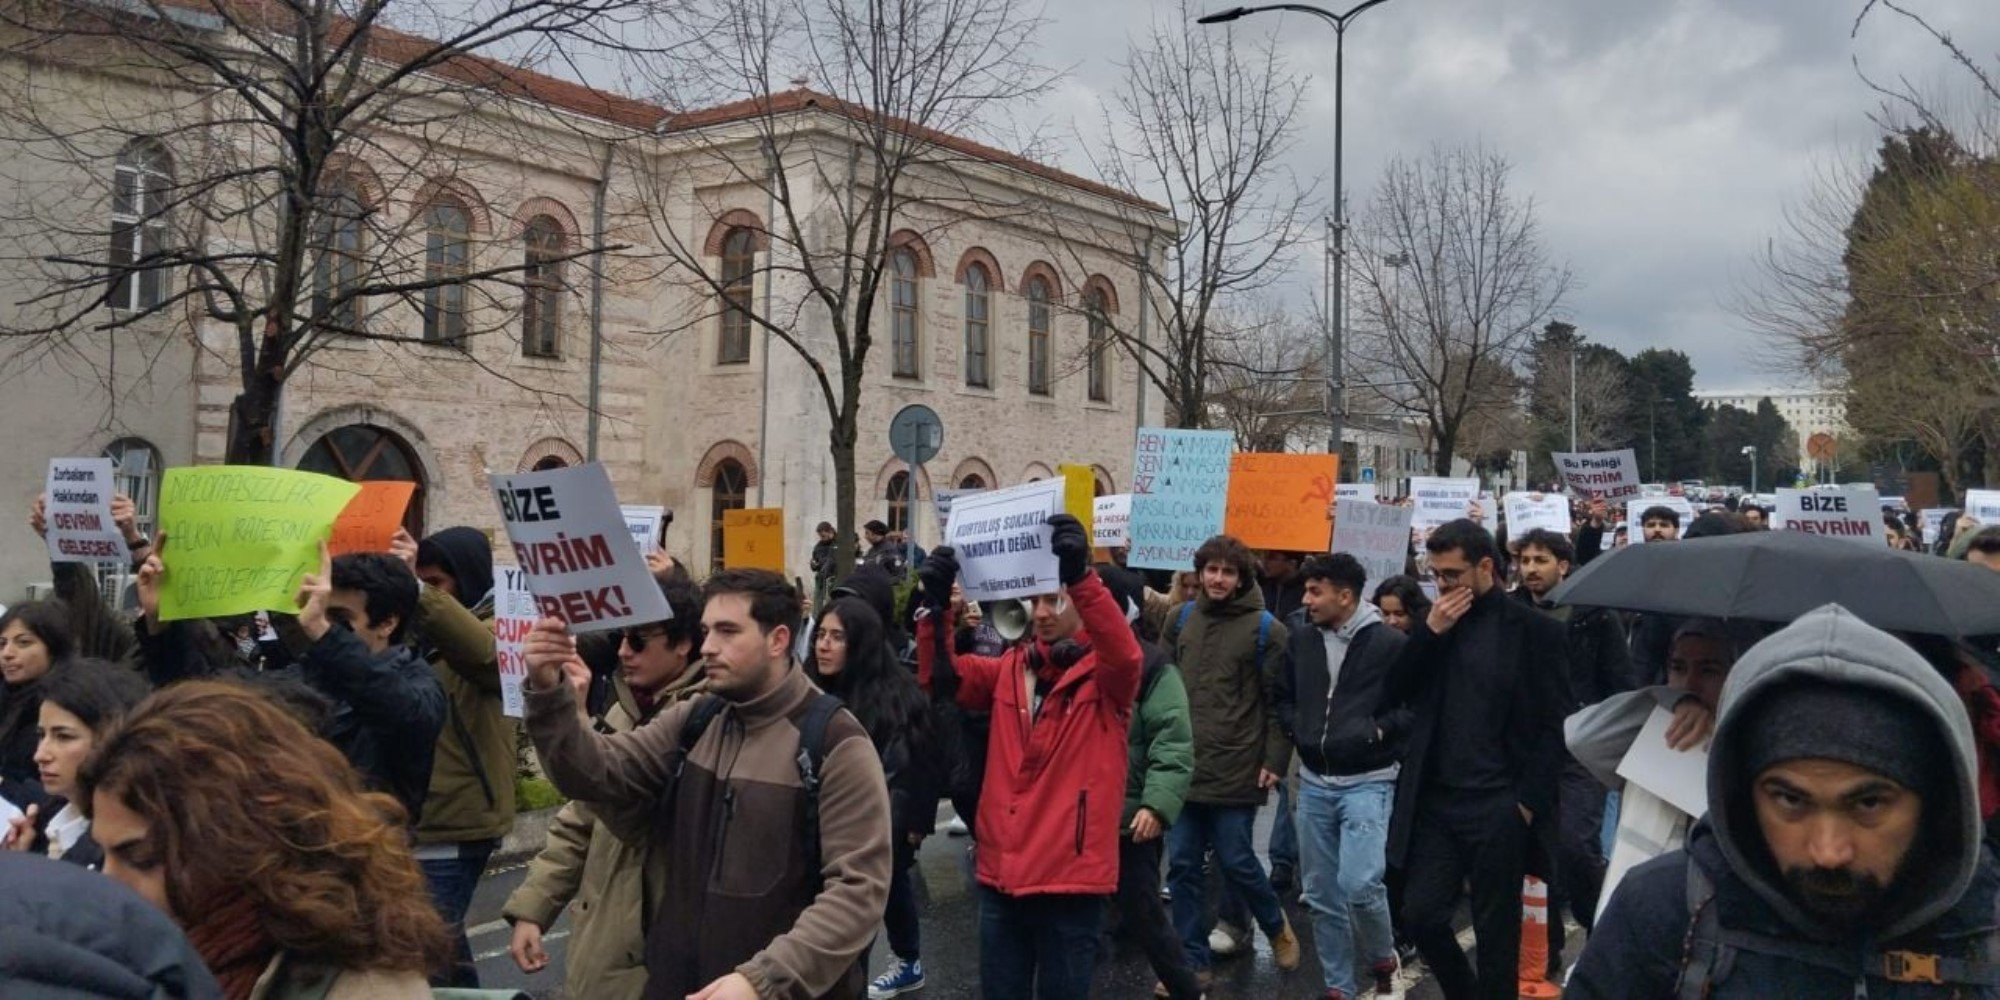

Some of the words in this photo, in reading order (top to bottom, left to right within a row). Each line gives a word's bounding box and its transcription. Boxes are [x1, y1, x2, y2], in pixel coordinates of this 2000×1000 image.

[1138, 434, 1166, 453] BEN
[1137, 455, 1163, 474] SEN
[1563, 459, 1579, 469] Bu
[1565, 472, 1623, 484] DEVRİM
[497, 480, 561, 523] BİZE
[1800, 493, 1848, 512] BİZE
[54, 510, 102, 531] DEVRİM
[1786, 517, 1871, 536] DEVRİM
[58, 539, 121, 556] GELECEK!
[513, 531, 616, 576] EVRİM
[534, 585, 633, 625] REK!
[495, 618, 533, 643] CUM
